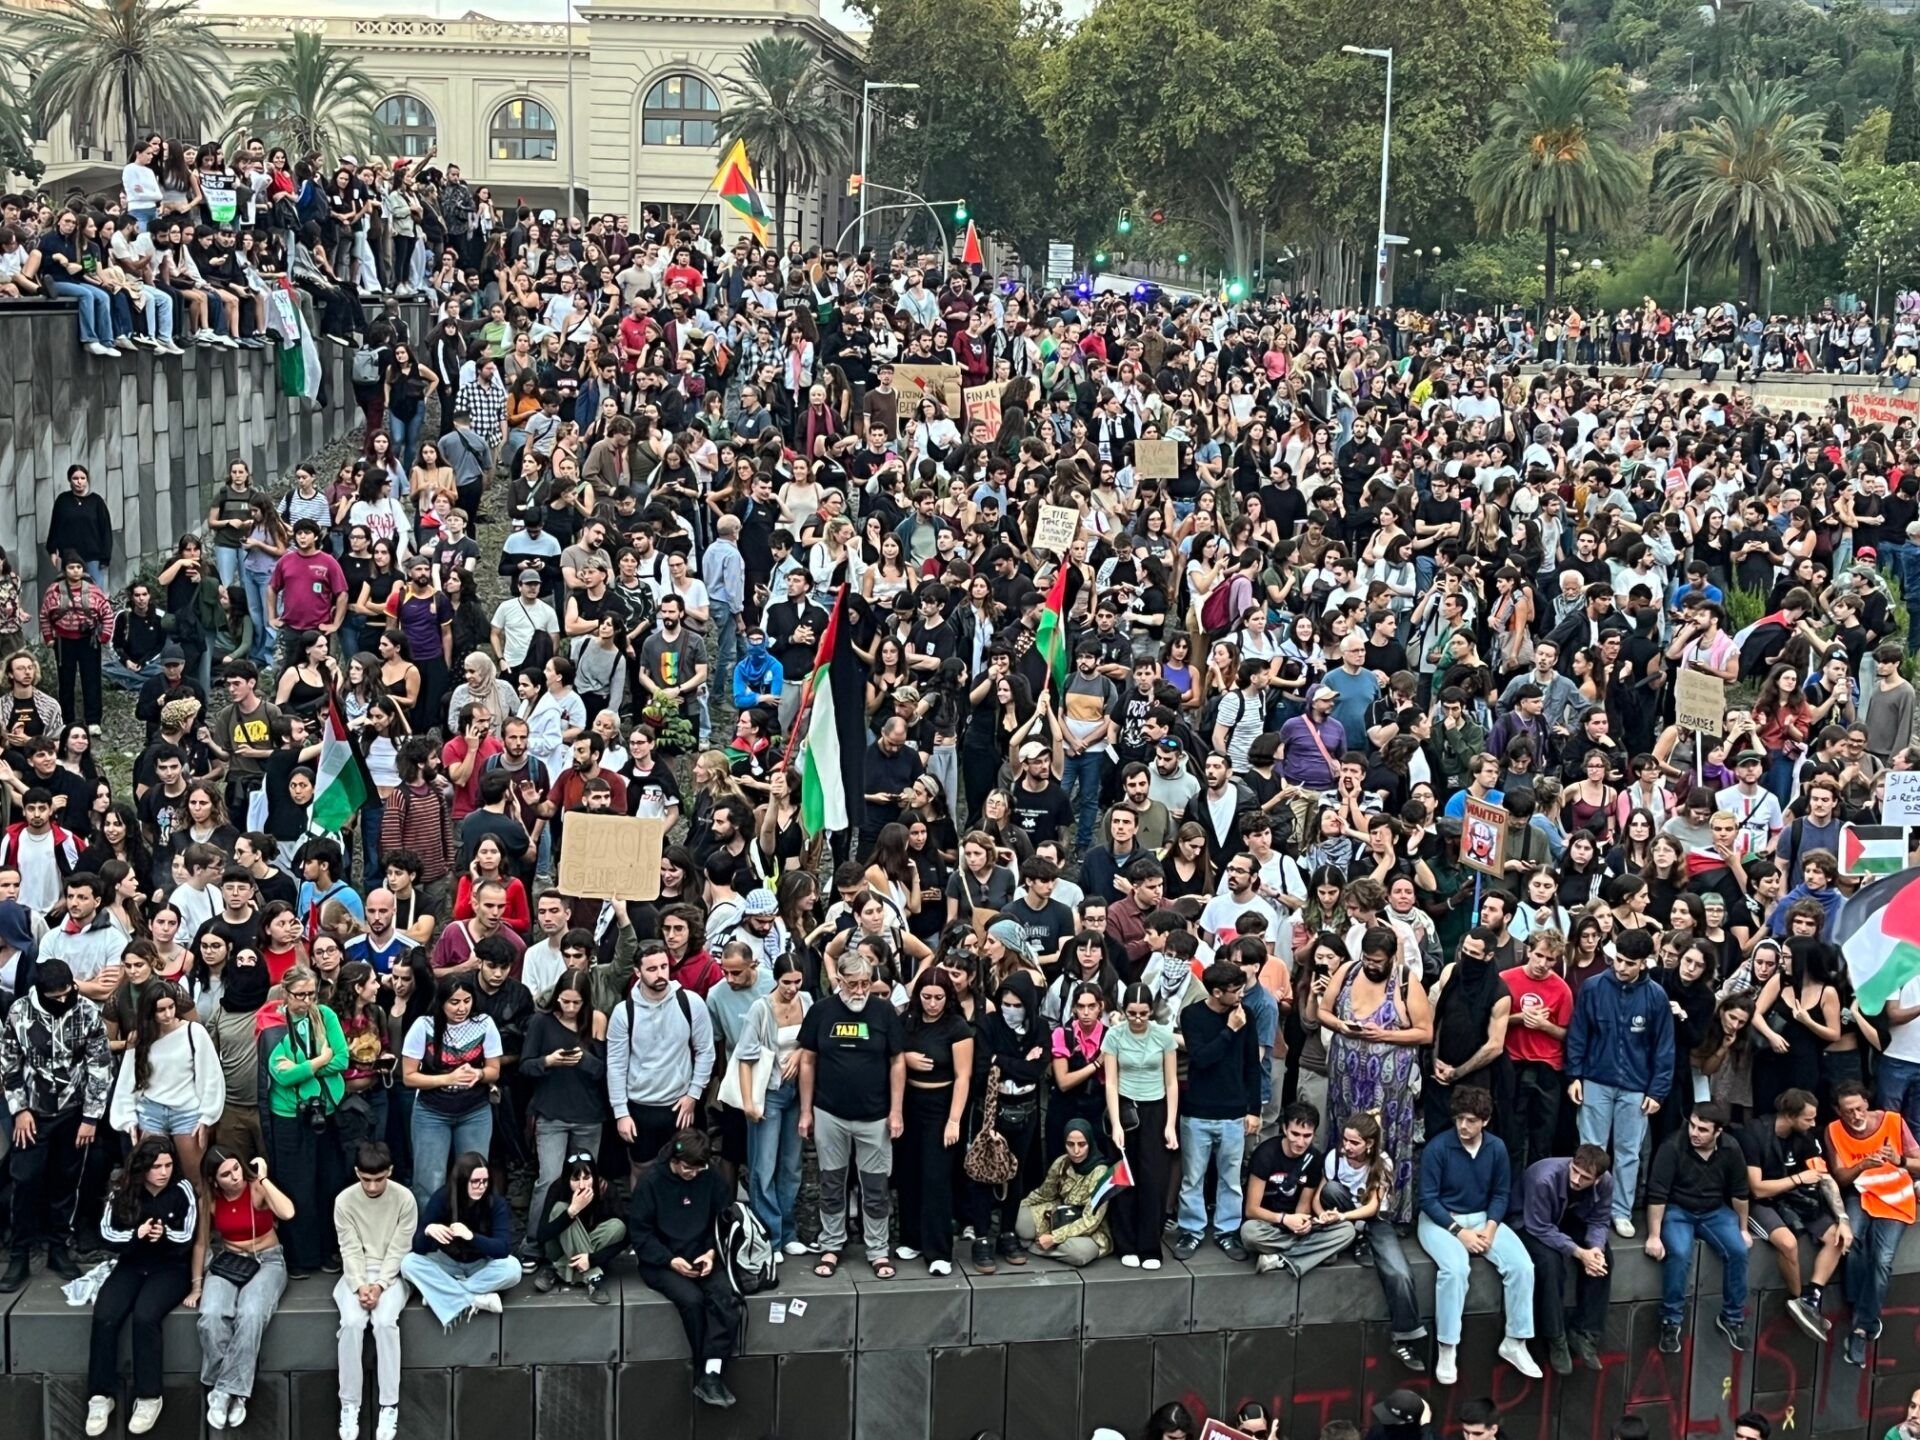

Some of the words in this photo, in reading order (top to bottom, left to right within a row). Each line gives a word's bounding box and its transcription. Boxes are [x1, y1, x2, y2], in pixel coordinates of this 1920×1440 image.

[966, 389, 997, 402] FINAL
[1679, 712, 1715, 732] COBARDES
[1903, 774, 1918, 784] LA
[1900, 793, 1920, 802] REVO
[1466, 802, 1504, 825] WANTED
[566, 820, 660, 863] STOP
[836, 1024, 858, 1036] TAXI
